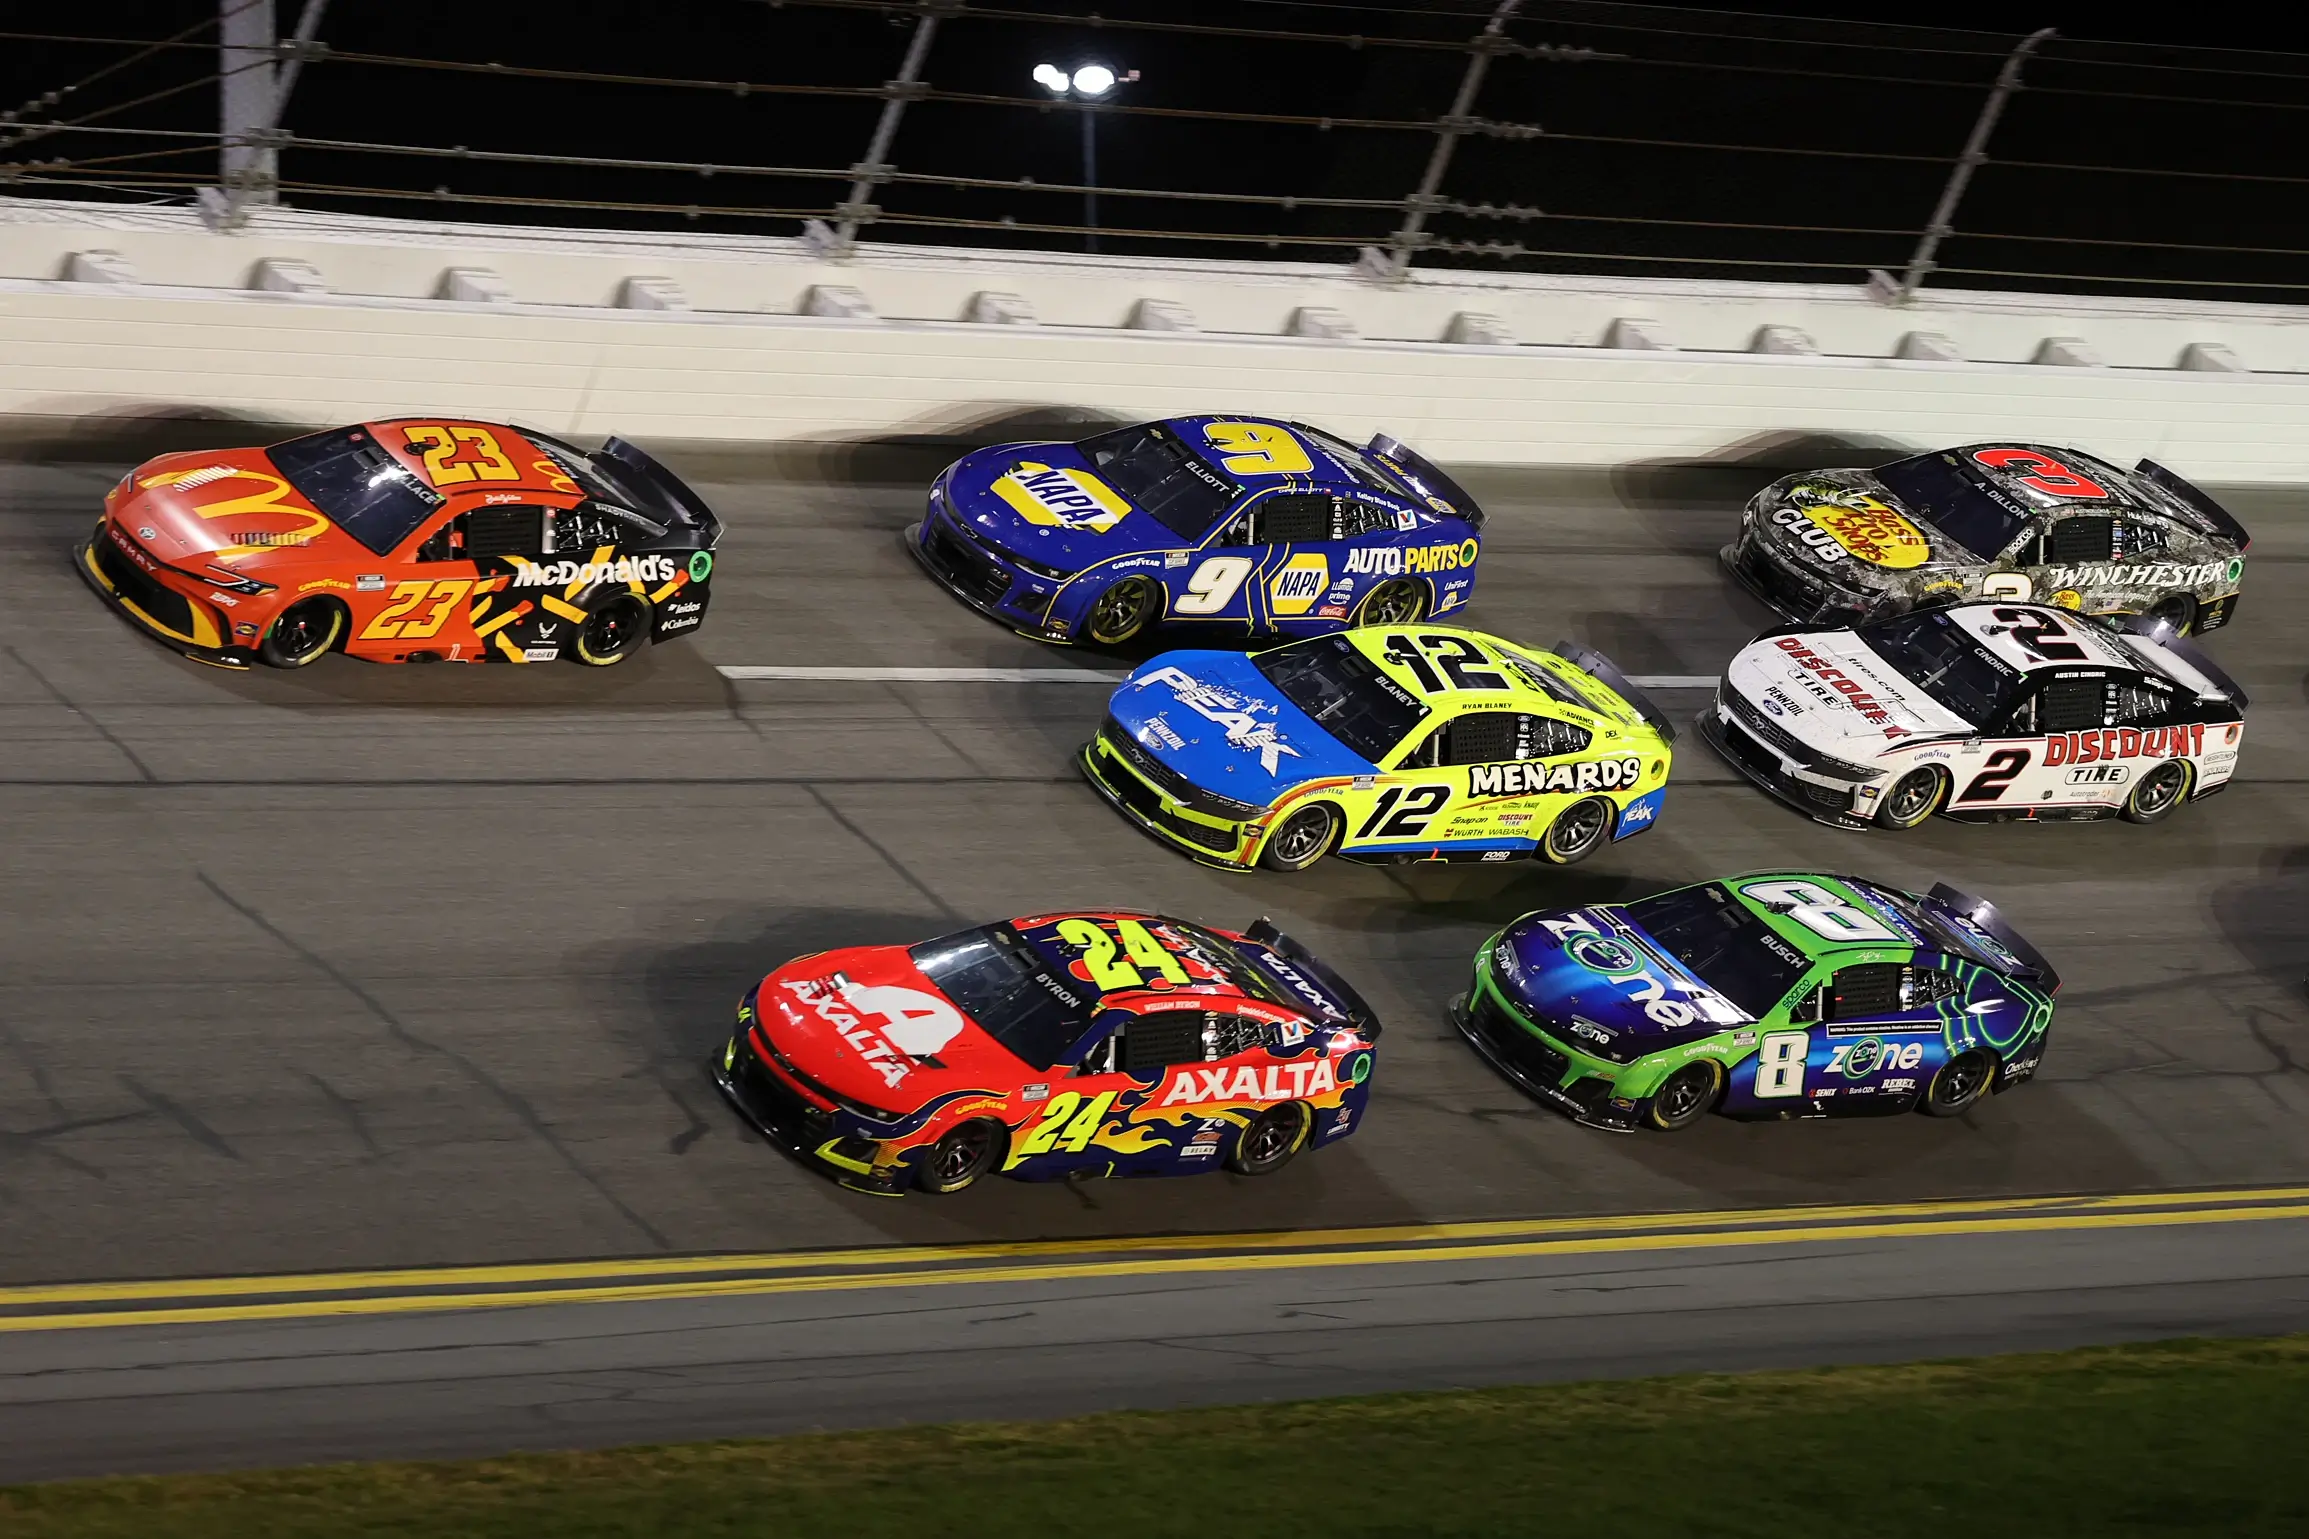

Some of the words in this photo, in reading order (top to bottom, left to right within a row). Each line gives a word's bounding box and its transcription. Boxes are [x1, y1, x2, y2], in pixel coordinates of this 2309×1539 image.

[402, 426, 521, 487] 23
[1203, 421, 1314, 475] 9
[1185, 460, 1230, 493] ELLIOTT
[1973, 448, 2109, 499] 3
[1016, 470, 1106, 524] NAPA
[1974, 482, 1985, 492] A.
[1987, 489, 2029, 520] DILLON
[1772, 508, 1849, 562] CLUB
[1865, 508, 1920, 546] Bass
[2008, 528, 2033, 554] sparco
[110, 530, 157, 572] CAMRY
[1112, 557, 1161, 570] GOODYEAR
[1343, 548, 1401, 575] AUTO
[1405, 544, 1460, 575] PARTS
[298, 578, 351, 592] GOODYEAR
[513, 554, 676, 587] McDonald's
[1174, 556, 1253, 614] 9
[1276, 571, 1321, 598] NAPA
[1444, 579, 1468, 592] UniFirst
[1923, 580, 1963, 592] GOODYEAR
[2050, 559, 2225, 589] WINCHESTER
[358, 580, 473, 640] 23
[1328, 592, 1351, 602] prime
[1991, 608, 2089, 663] 2
[526, 650, 546, 659] Mobil
[1384, 634, 1512, 693] 12
[1973, 647, 2013, 677] CINDRIC
[1374, 676, 1417, 706] BLANEY
[1795, 672, 1838, 706] TIRE
[1847, 657, 1906, 702] tires.com
[1484, 702, 1512, 710] BLANEY
[1764, 686, 1804, 717] PENNZOIL
[1132, 666, 1302, 777] PEAK
[1144, 716, 1186, 751] PENNZOIL
[1914, 749, 1950, 761] GOODYEAR
[2042, 724, 2204, 766] DISCOUNT
[1469, 758, 1640, 797] MENARDS
[1956, 748, 2031, 801] 2
[1303, 787, 1344, 799] GOODYEAR
[1354, 785, 1450, 838] 12
[1498, 813, 1533, 821] DISCOUNT
[1621, 806, 1654, 828] PEAK
[1489, 828, 1529, 836] WABASH
[1483, 851, 1510, 859] FORD
[1739, 880, 1904, 942] 8
[1895, 921, 1925, 947] OWN
[1056, 919, 1191, 992] 24
[1759, 934, 1805, 969] BUSCH
[1035, 973, 1081, 1008] BYRON
[1260, 952, 1348, 1020] AXALTA
[1782, 979, 1810, 1009] sparco
[779, 981, 911, 1089] AXALTA
[1684, 1043, 1729, 1057] GOODYEAR
[1754, 1030, 1810, 1099] 8
[1160, 1059, 1335, 1106] AXALTA
[1815, 1087, 1838, 1097] SENIX
[1848, 1087, 1862, 1095] Bank
[1881, 1078, 1916, 1090] REBEL
[1018, 1091, 1118, 1158] 24
